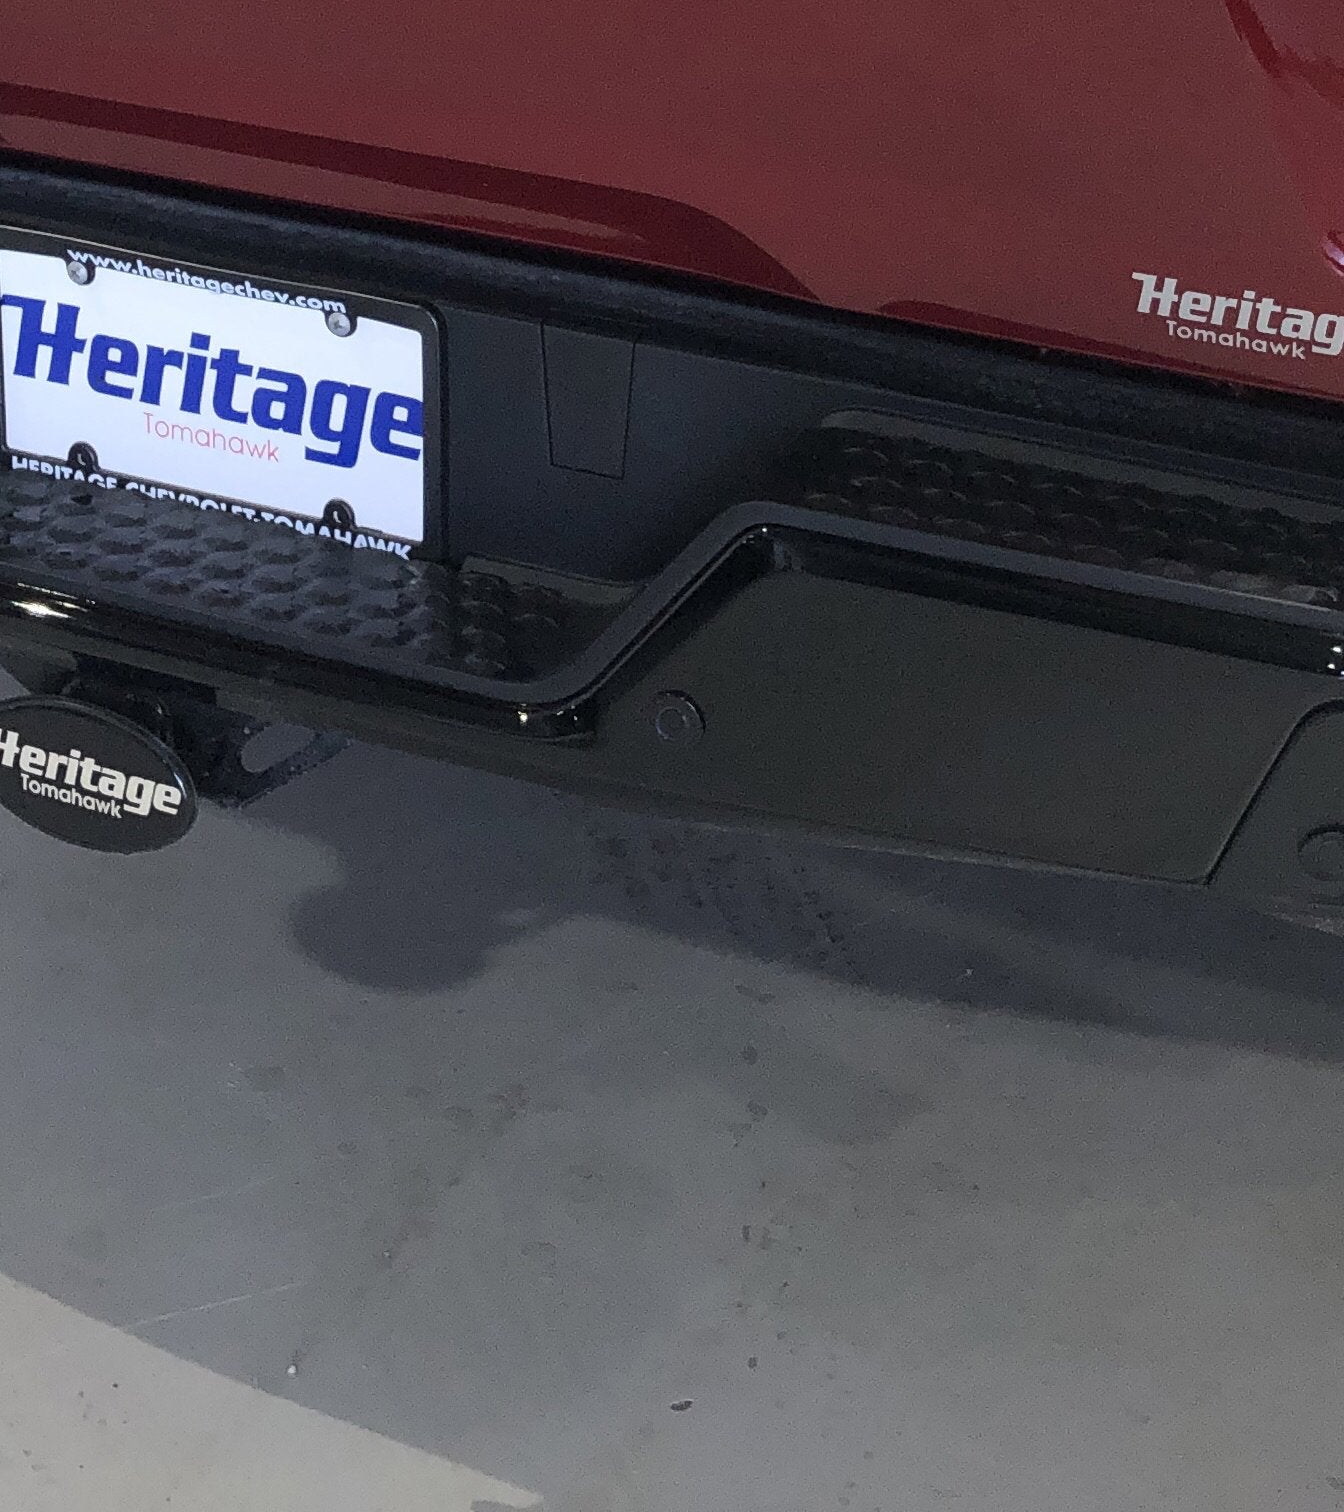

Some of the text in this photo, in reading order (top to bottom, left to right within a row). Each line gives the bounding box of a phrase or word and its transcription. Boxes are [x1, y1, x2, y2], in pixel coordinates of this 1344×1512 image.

[66, 249, 347, 314] www.heritagechev.com
[1165, 320, 1306, 360] Tomahawk
[0, 293, 424, 468] Heritage
[143, 411, 280, 463] Tomahawk
[19, 772, 123, 820] Tomahawk
